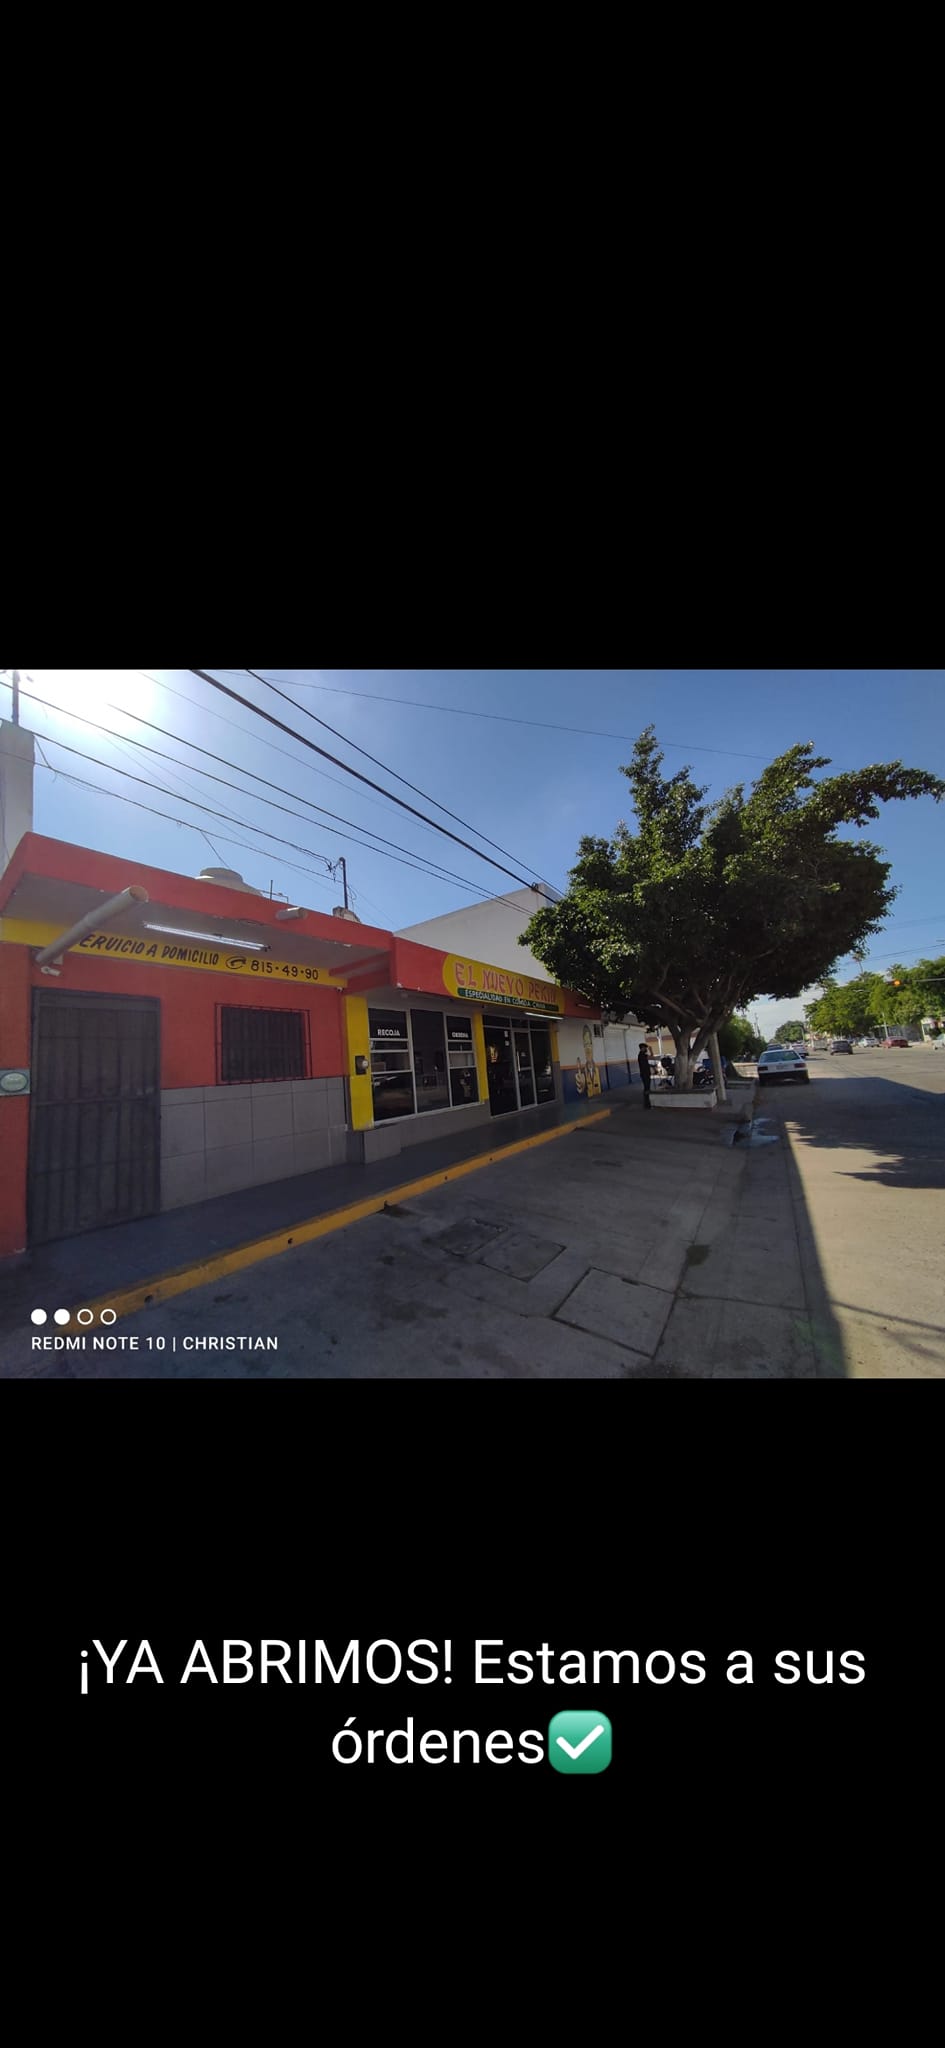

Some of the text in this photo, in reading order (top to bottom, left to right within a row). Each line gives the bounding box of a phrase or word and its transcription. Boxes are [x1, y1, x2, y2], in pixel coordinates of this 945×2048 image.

[146, 944, 158, 957] A
[161, 945, 219, 966] DOMICILIO
[455, 962, 477, 987] EL
[483, 968, 524, 995] NUEVO
[377, 1029, 401, 1037] RECOJA
